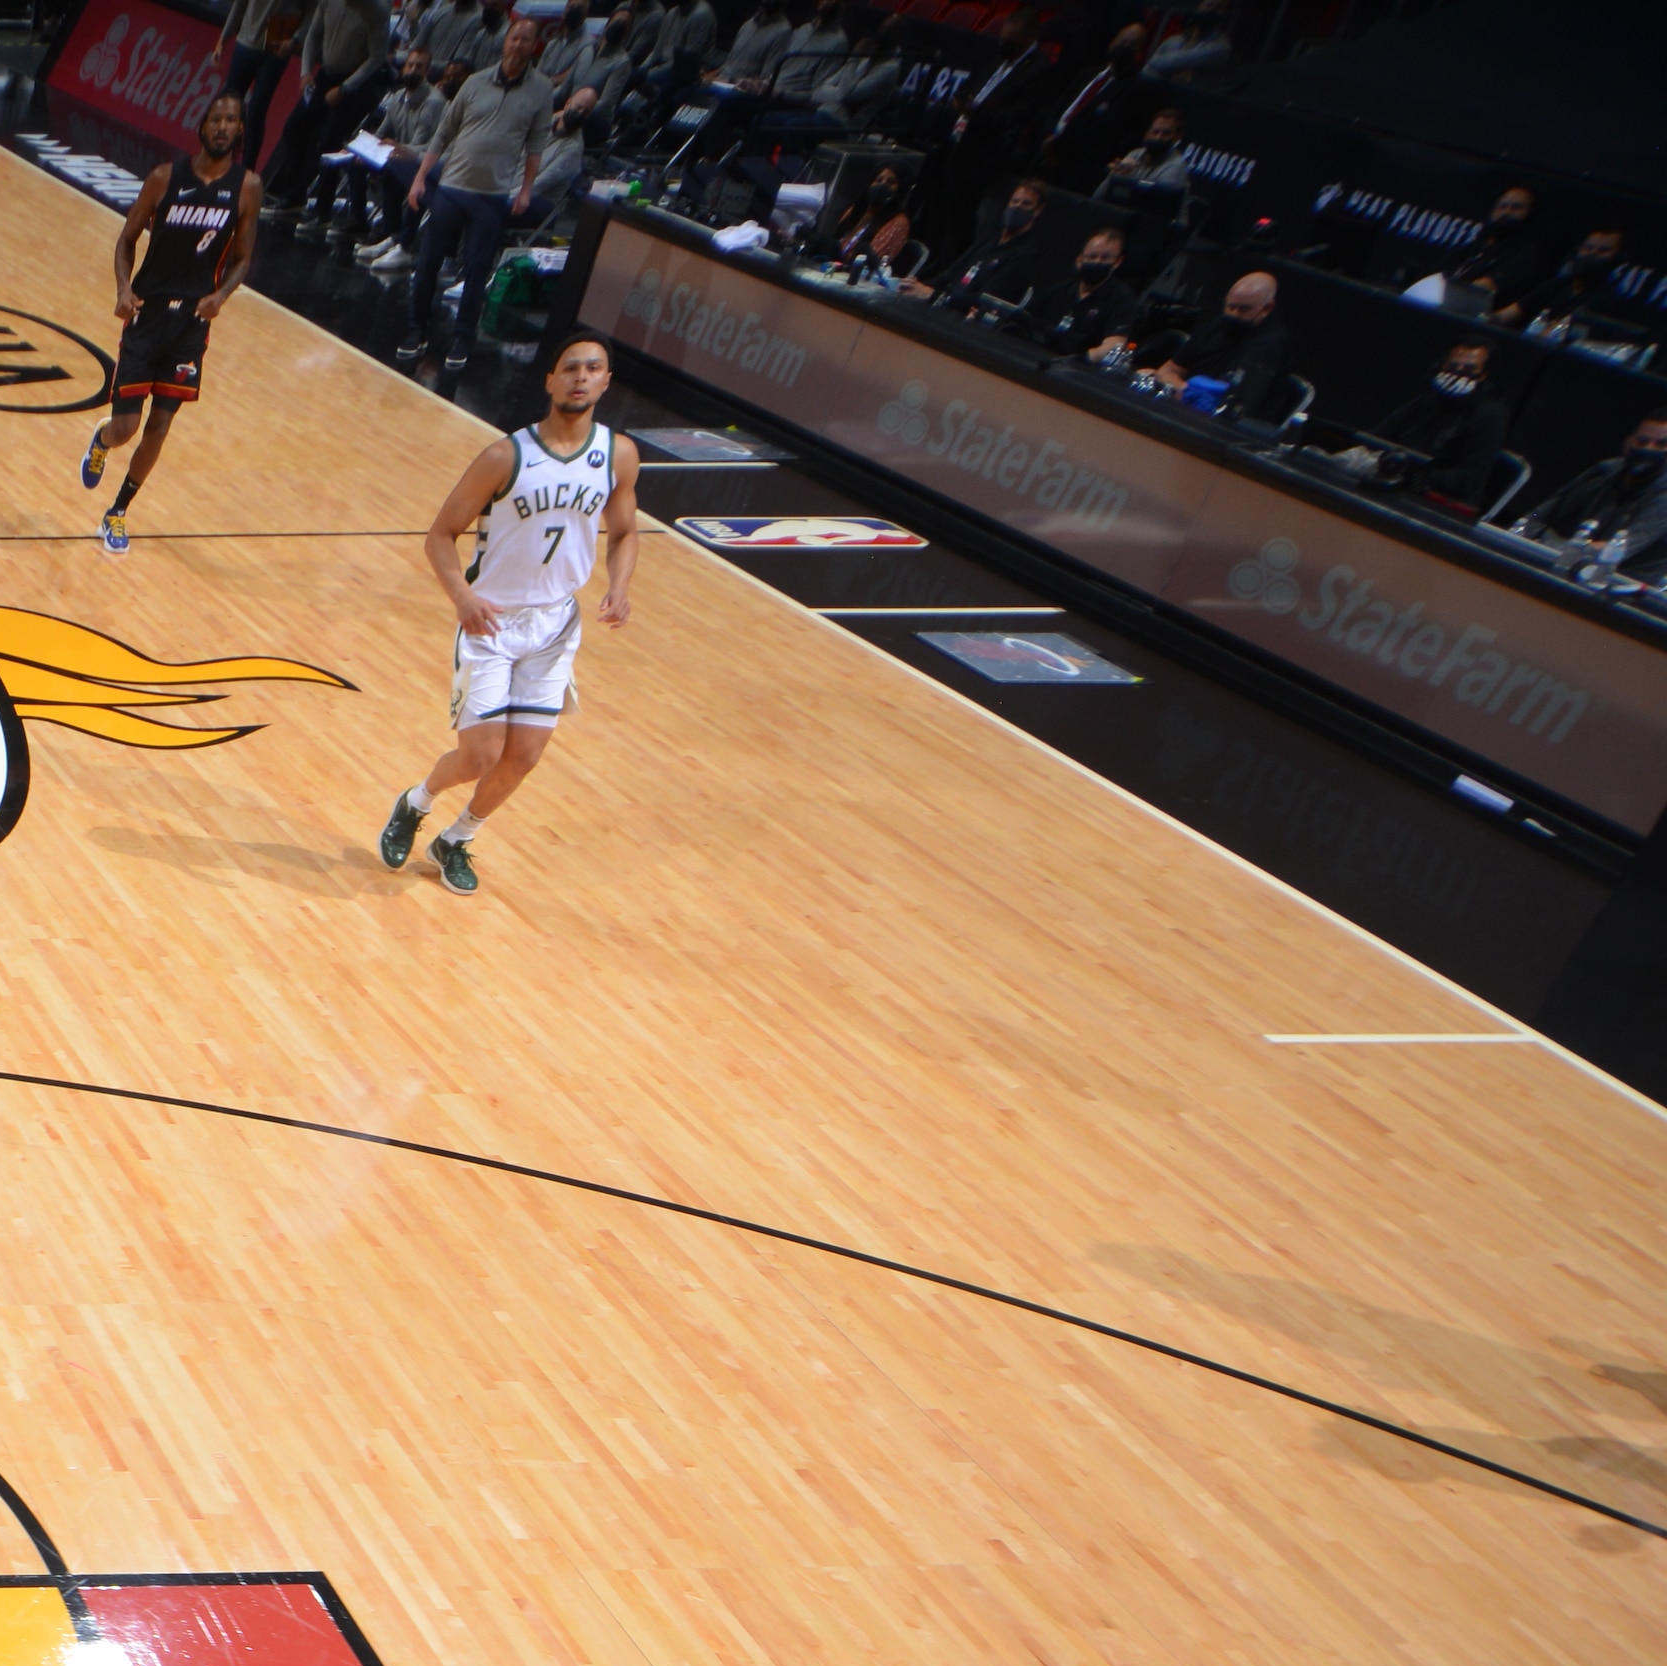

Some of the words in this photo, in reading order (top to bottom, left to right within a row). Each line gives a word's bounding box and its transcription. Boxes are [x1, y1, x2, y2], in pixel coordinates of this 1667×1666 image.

[165, 204, 231, 229] MIAMI
[1386, 203, 1485, 248] PLAYOFFS
[196, 230, 217, 253] 8
[513, 484, 604, 519] BUCKS
[542, 526, 565, 564] 7
